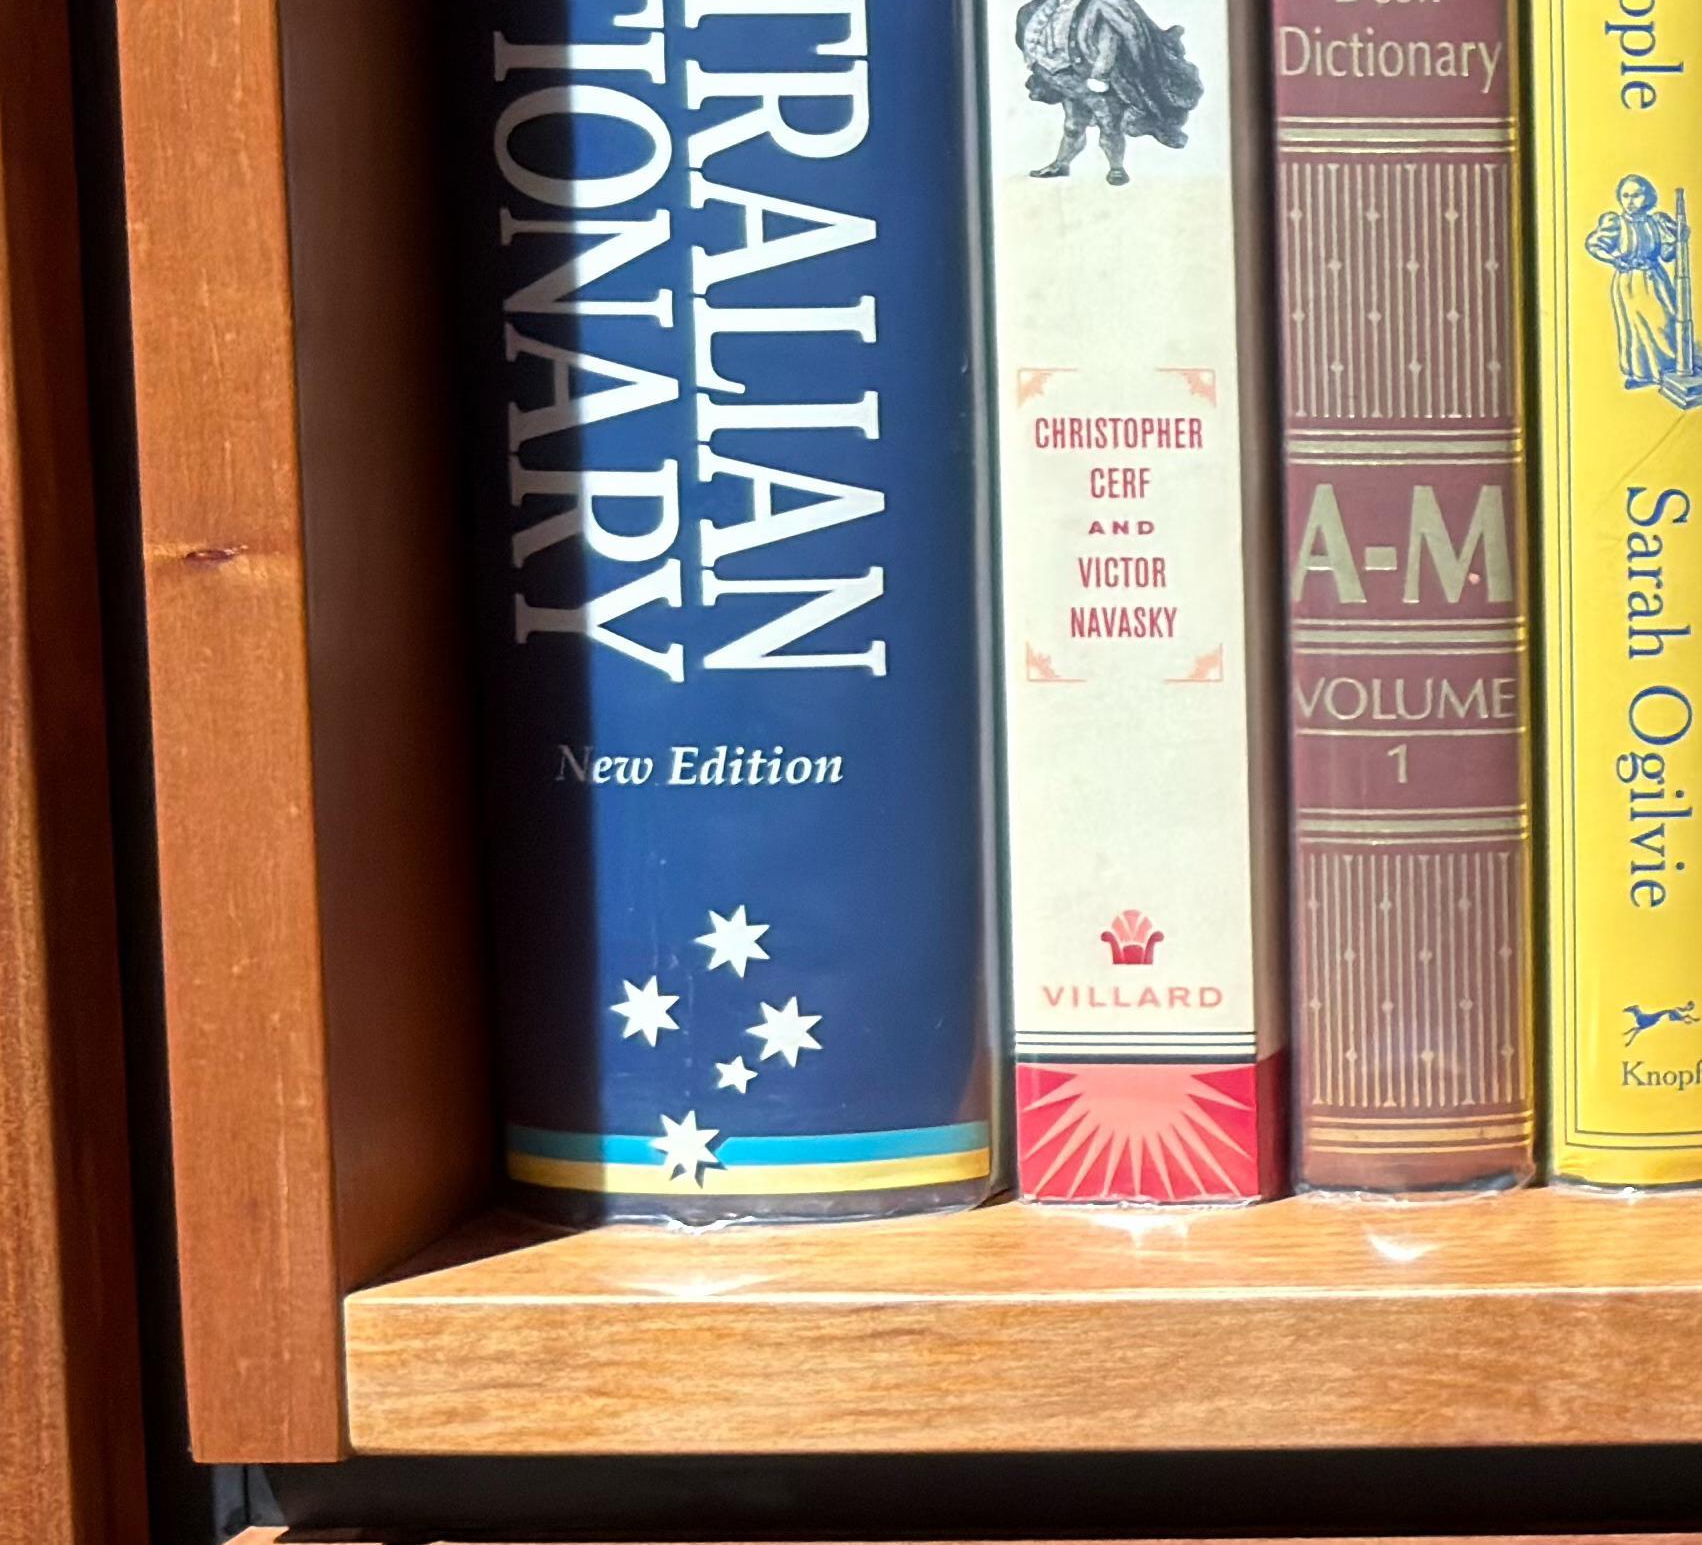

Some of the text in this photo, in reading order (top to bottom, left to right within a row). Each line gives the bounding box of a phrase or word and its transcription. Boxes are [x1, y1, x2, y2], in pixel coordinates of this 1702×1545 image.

[1279, 26, 1501, 93] Dictionary
[1034, 417, 1204, 450] CHRISTOPHER
[1089, 468, 1151, 499] CERF
[1088, 520, 1155, 535] AND
[1292, 483, 1513, 604] A-M
[1078, 556, 1167, 589] VICTOR
[1069, 607, 1178, 639] NAVASKY
[1297, 677, 1516, 720] VOLUME
[1616, 485, 1692, 909] Sarah Ogilvie
[555, 743, 843, 787] New Edition
[1386, 744, 1408, 784] 1
[1042, 986, 1224, 1009] VILLARD
